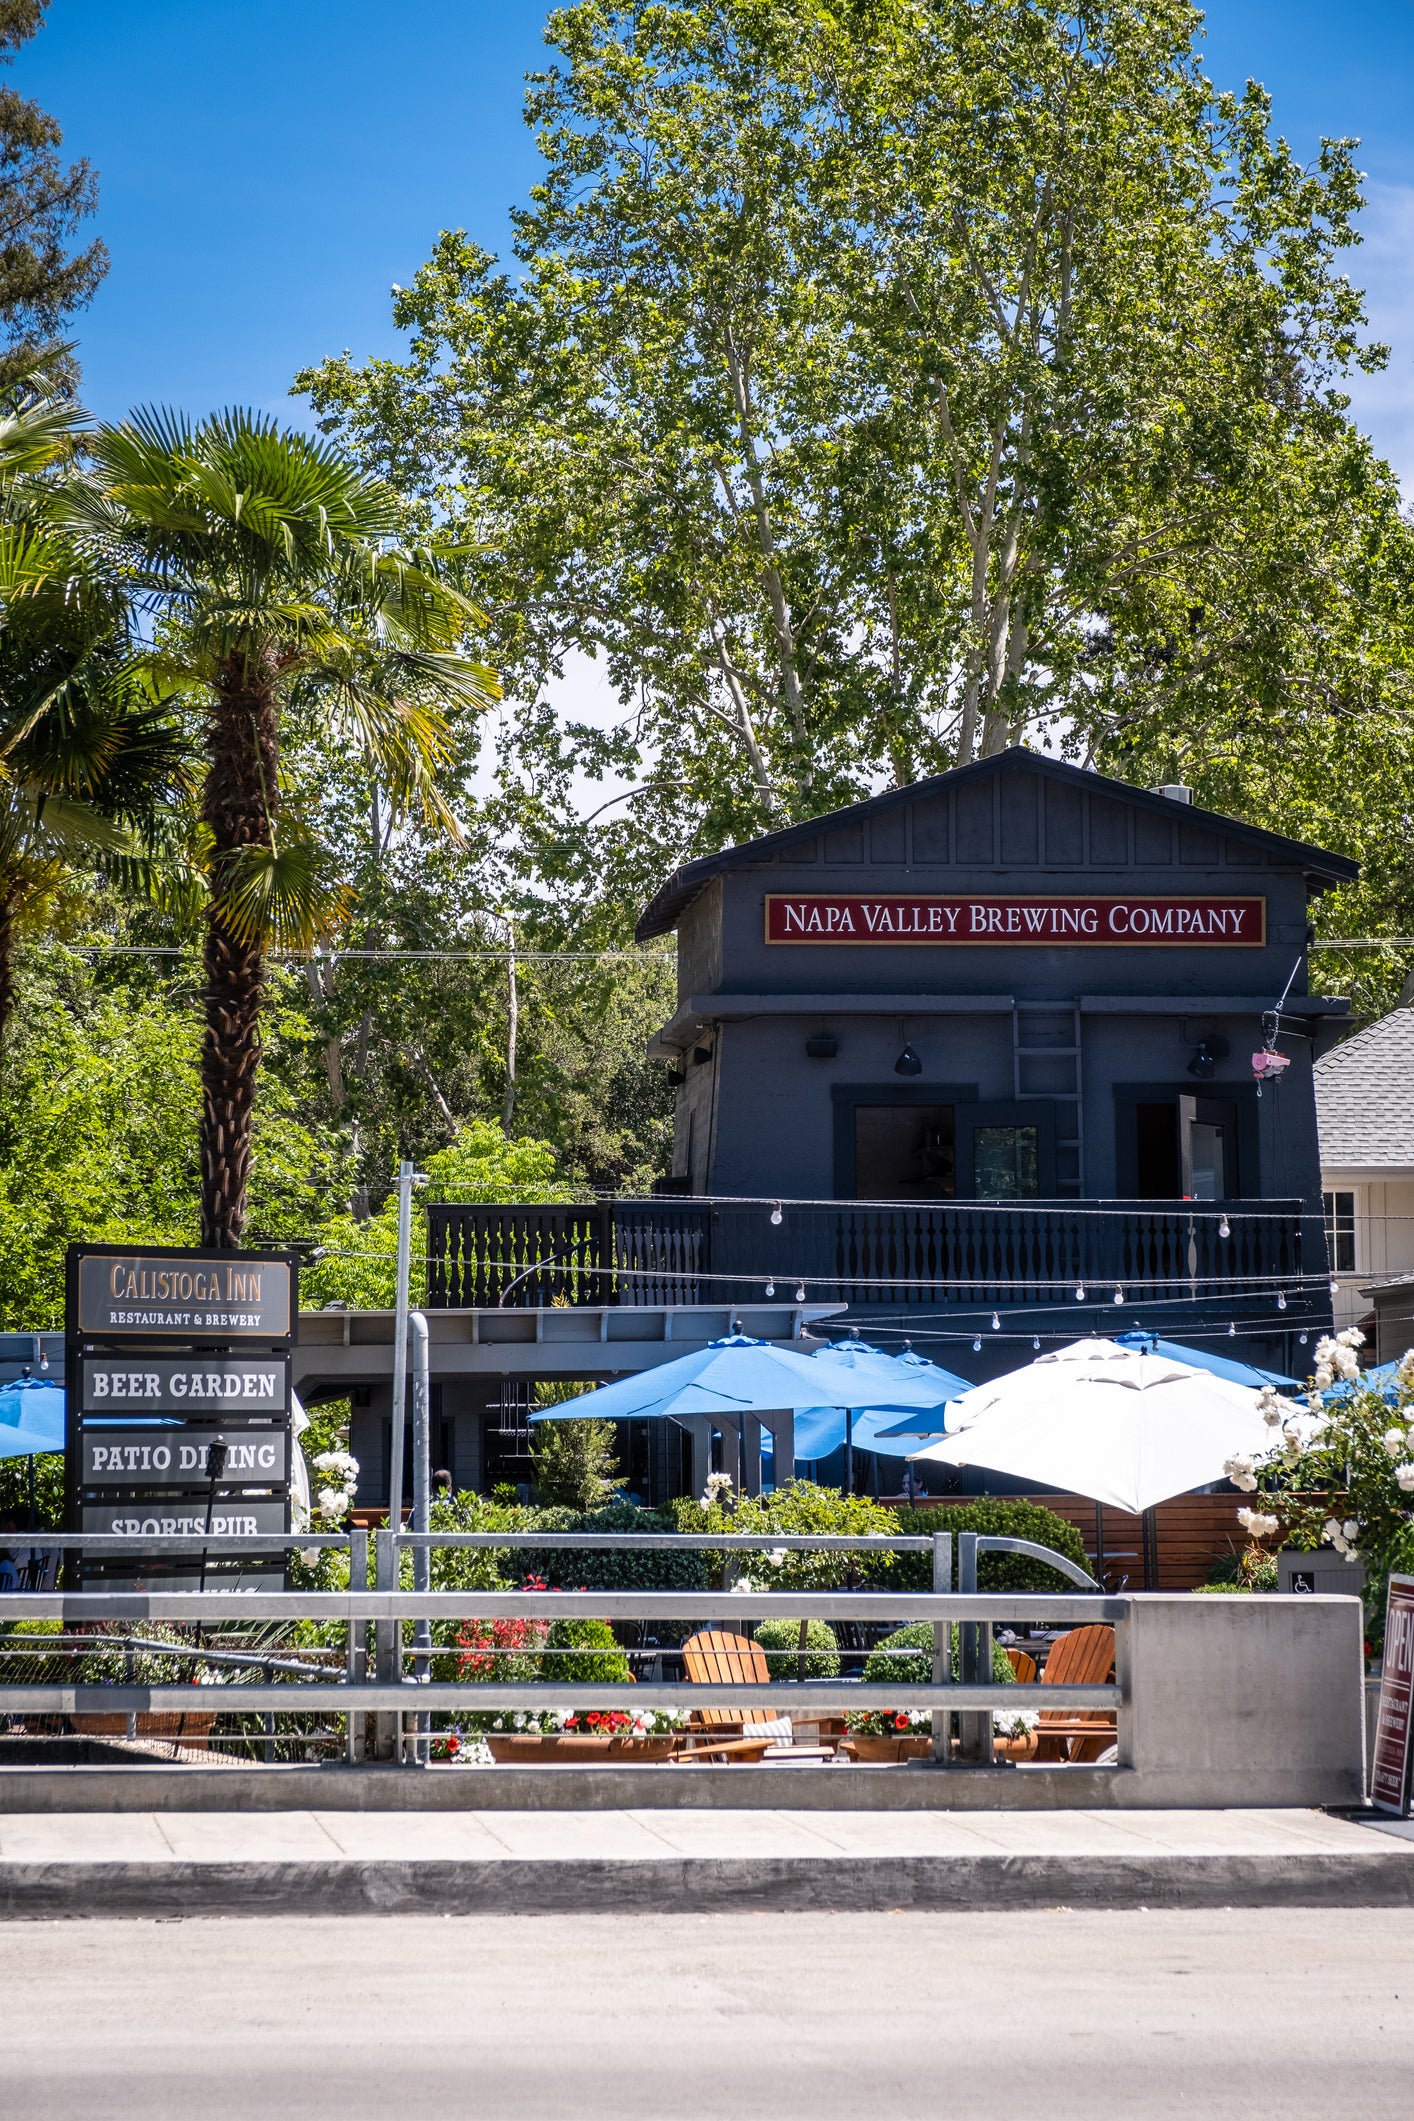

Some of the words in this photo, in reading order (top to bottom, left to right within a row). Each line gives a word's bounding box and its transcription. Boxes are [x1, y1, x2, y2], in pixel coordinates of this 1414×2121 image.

[784, 904, 855, 932] NAPA
[861, 905, 962, 933] VALLEY
[970, 905, 1099, 934] BREWING
[1108, 905, 1247, 934] COMPANY
[109, 1263, 221, 1301] CALISTOGA
[226, 1267, 262, 1302] INN
[109, 1311, 191, 1326] RESTAURANT
[194, 1313, 202, 1326] &
[205, 1314, 262, 1327] BREWERY
[93, 1373, 162, 1397] BEER
[169, 1373, 276, 1398] GARDEN
[92, 1446, 171, 1471] PATIO
[179, 1444, 276, 1469] DIING
[1386, 1607, 1414, 1673] OPEN
